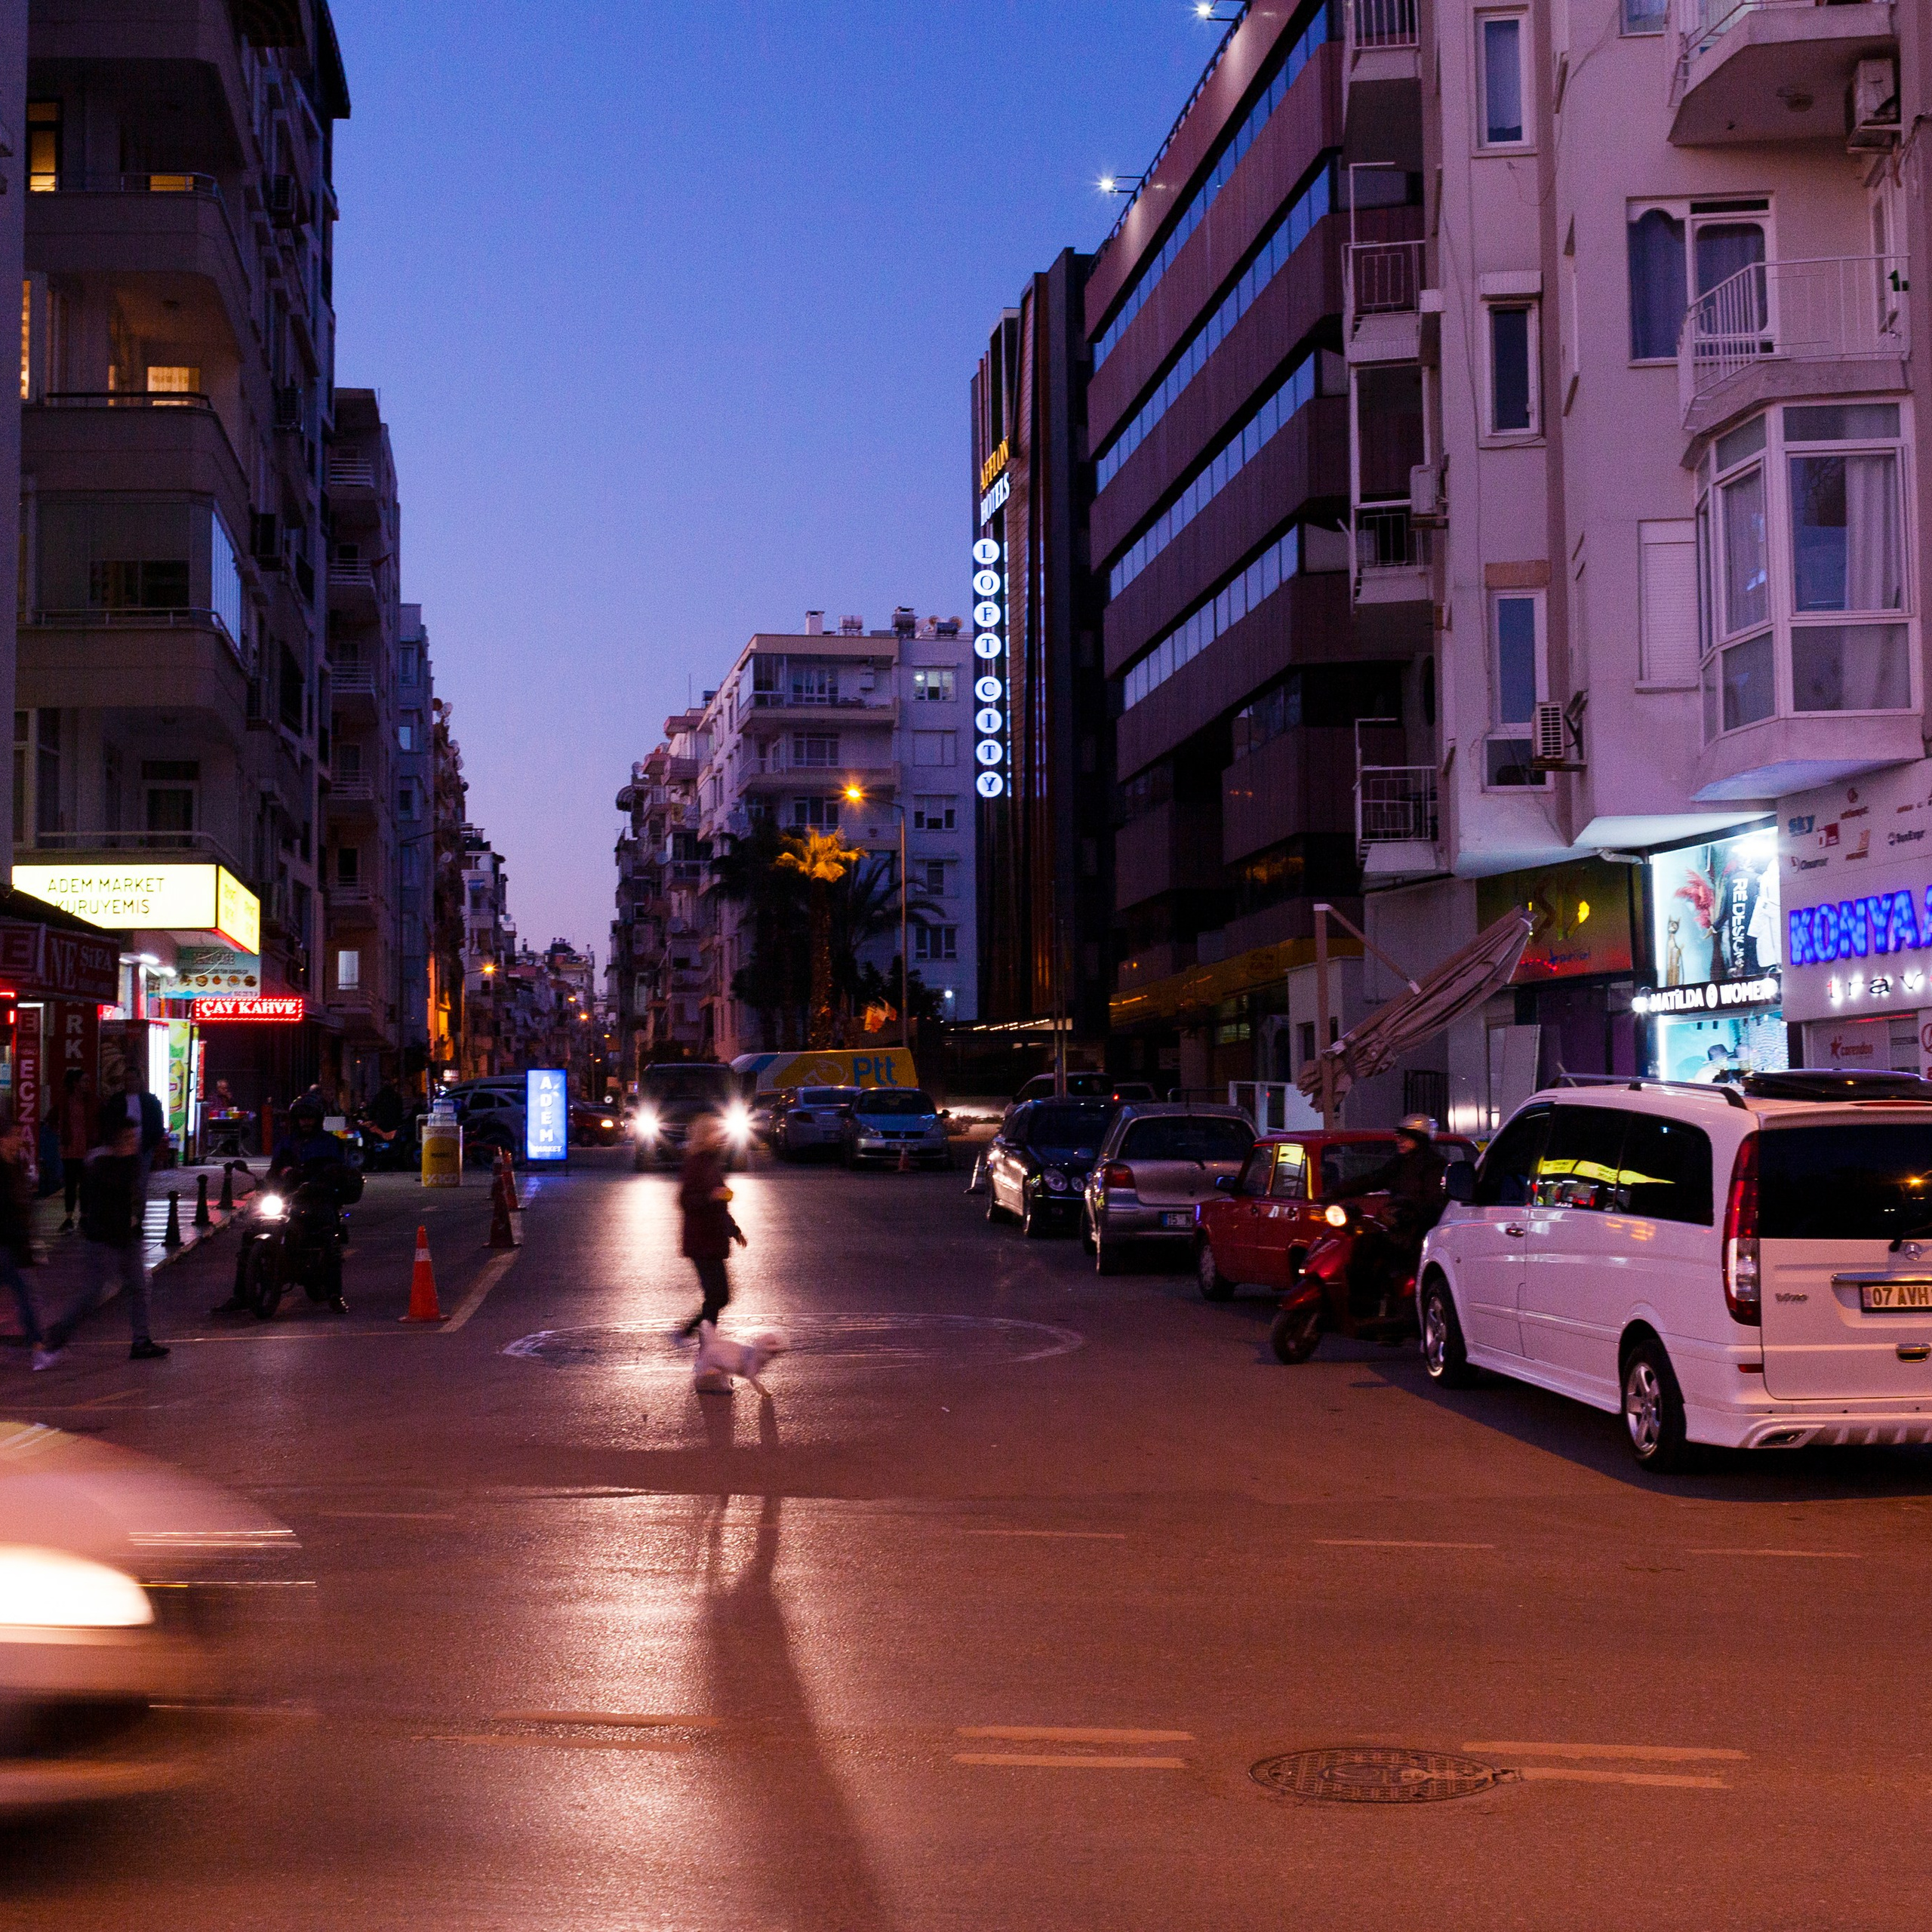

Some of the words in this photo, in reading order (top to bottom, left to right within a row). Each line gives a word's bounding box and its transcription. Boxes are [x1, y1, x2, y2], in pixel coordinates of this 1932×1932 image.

[980, 472, 1011, 527] HOTELS
[979, 543, 995, 655] LOFT
[980, 681, 998, 792] CITY
[48, 878, 93, 893] ADEM
[99, 878, 165, 892] MARKET
[1827, 971, 1932, 998] trav
[202, 1001, 238, 1016] ÇAY
[238, 1001, 297, 1014] KAHVE
[1650, 988, 1705, 1012] MATİLDA
[853, 1056, 899, 1086] Ptt
[540, 1076, 554, 1143] ADEM
[1872, 1287, 1893, 1306] 07
[1897, 1287, 1929, 1306] AVH
